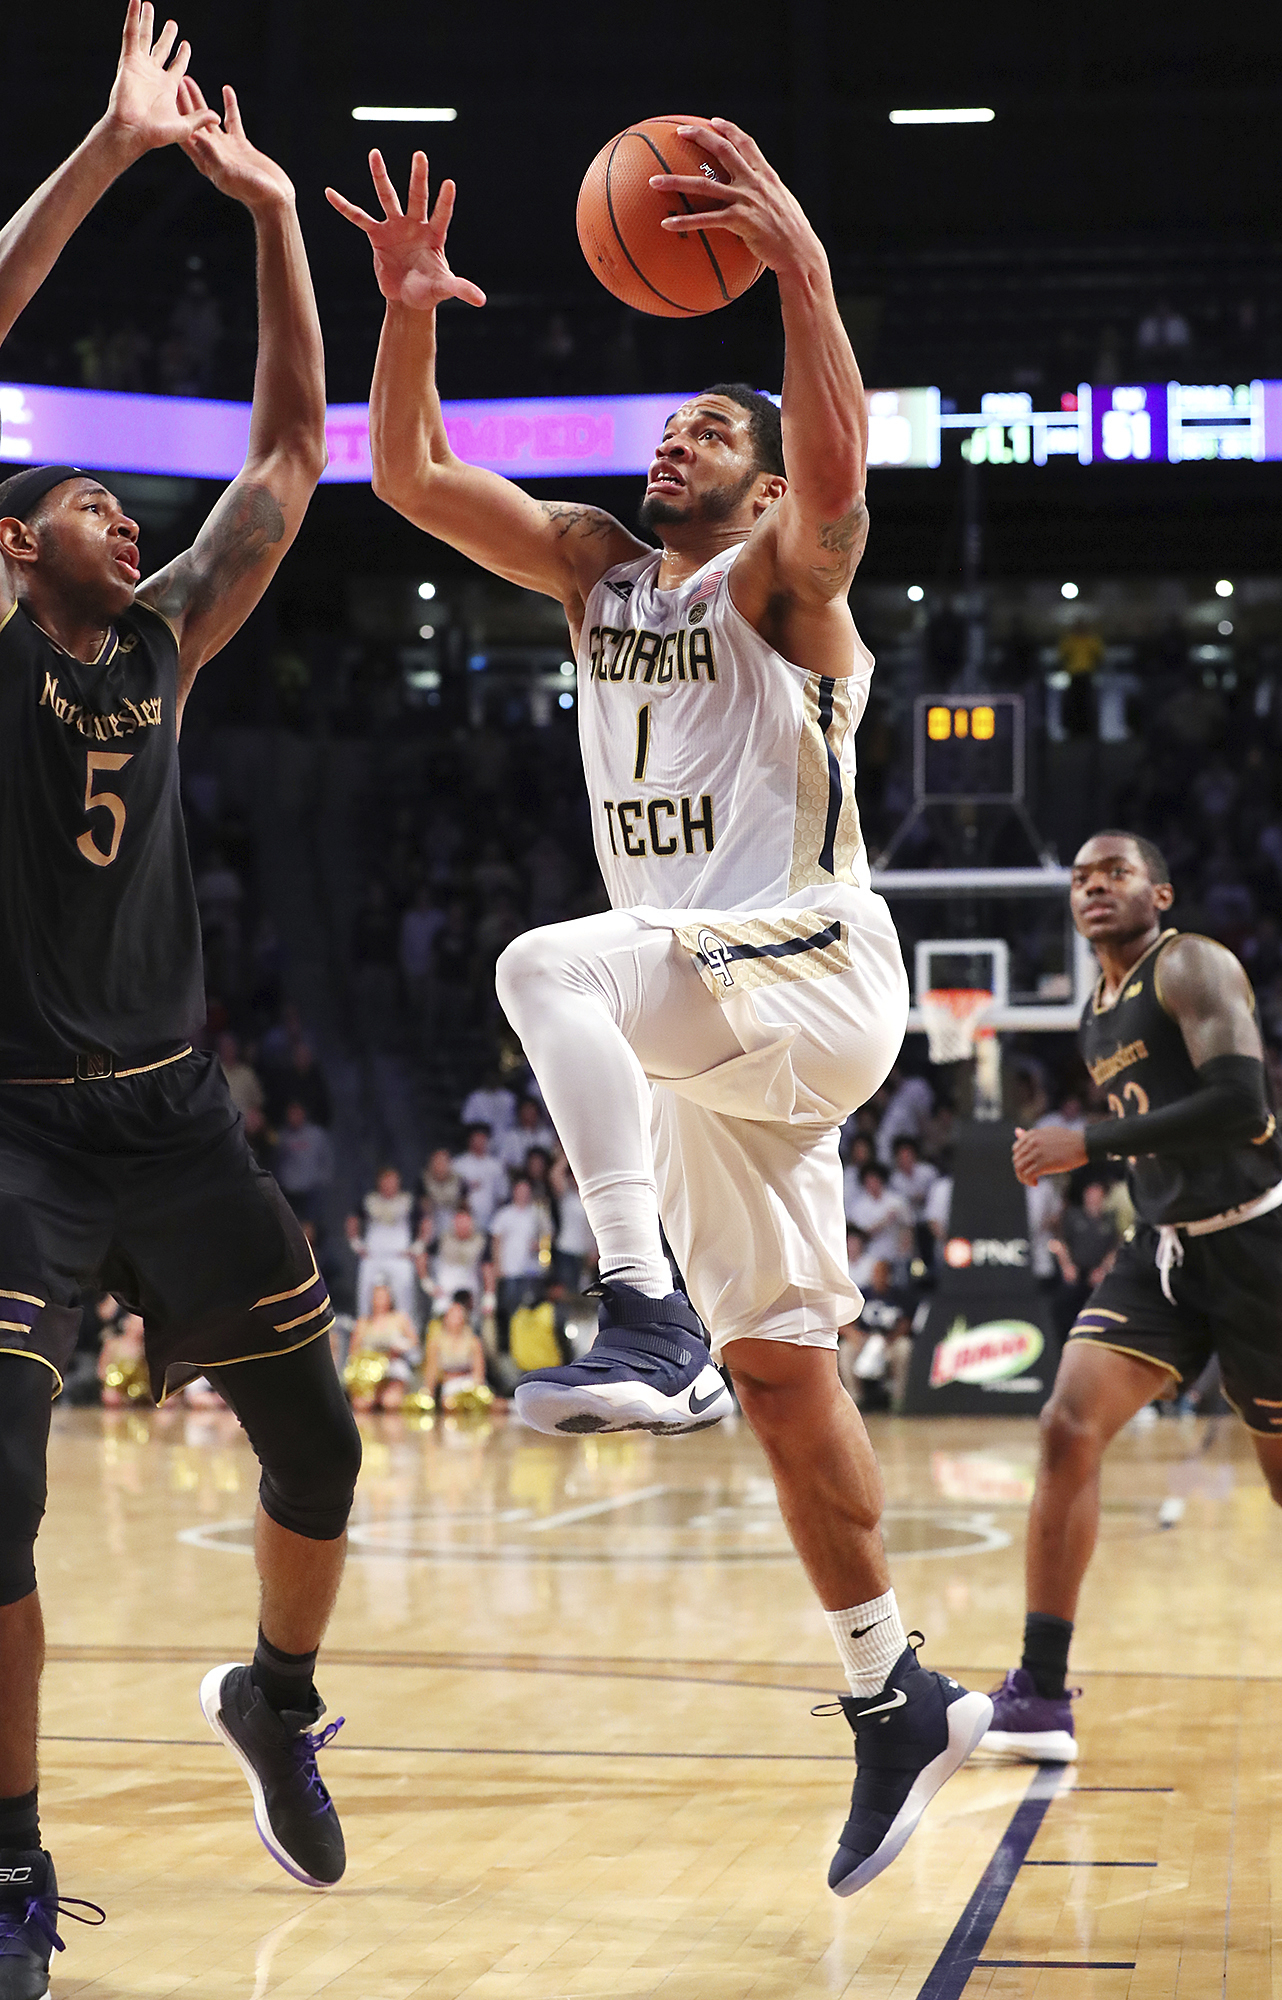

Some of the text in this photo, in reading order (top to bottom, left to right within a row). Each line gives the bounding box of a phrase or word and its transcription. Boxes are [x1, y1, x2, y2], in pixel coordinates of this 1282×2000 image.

[590, 626, 716, 684] GEORGIA
[632, 701, 651, 783] 1
[76, 750, 134, 867] 5
[603, 795, 716, 858] TECH
